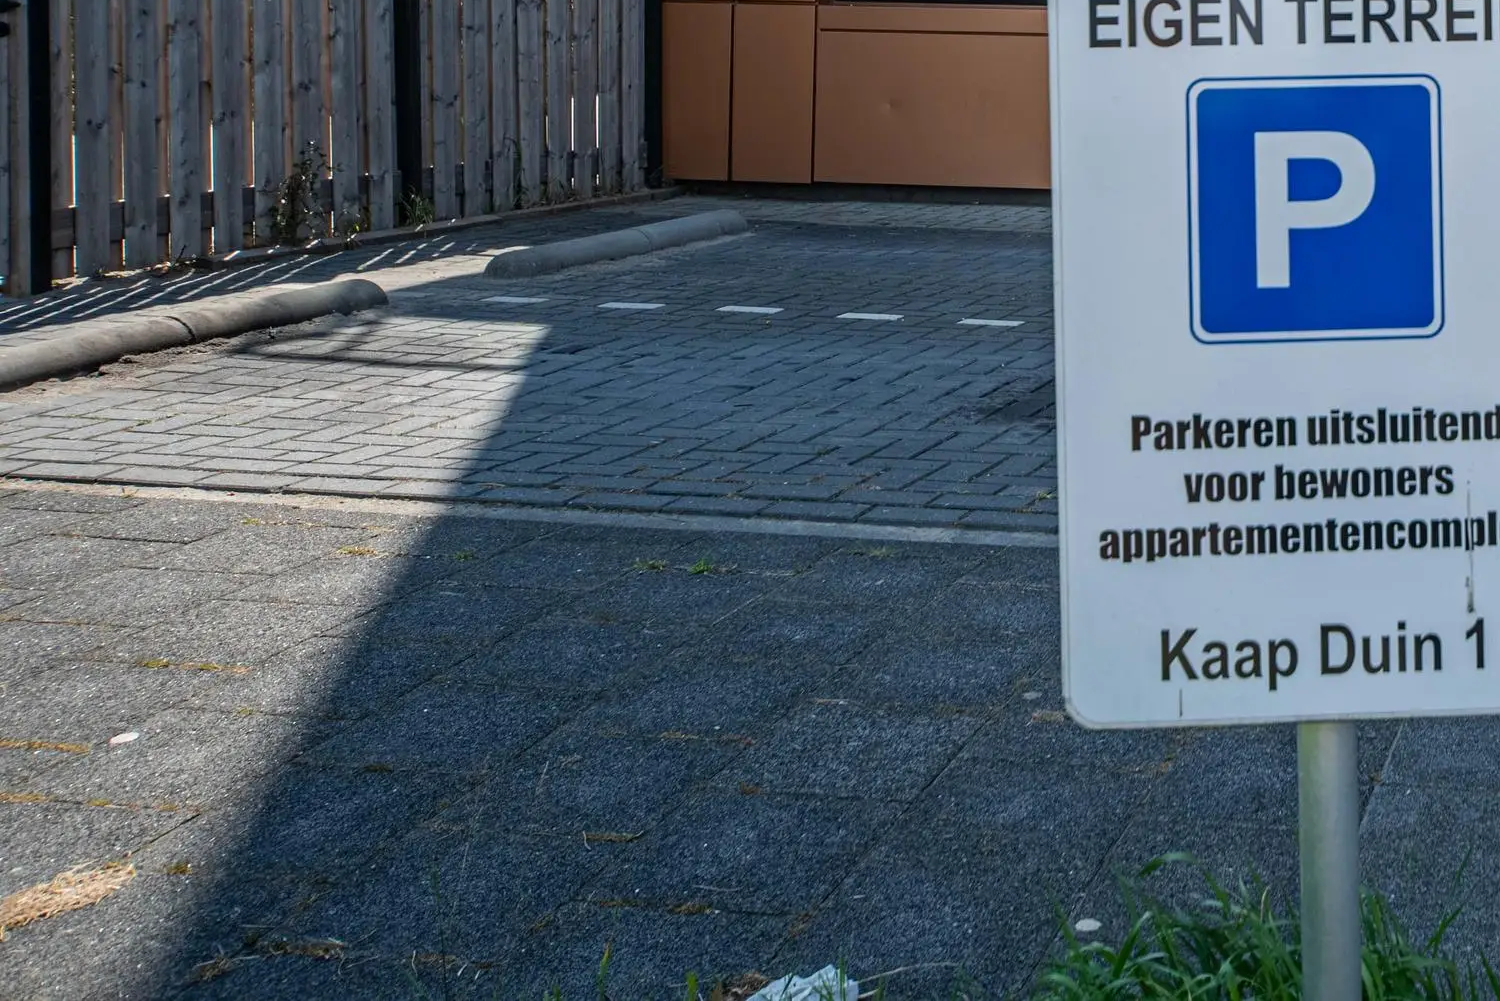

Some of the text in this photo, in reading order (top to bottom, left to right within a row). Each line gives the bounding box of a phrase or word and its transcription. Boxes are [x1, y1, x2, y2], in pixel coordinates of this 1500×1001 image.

[1253, 130, 1377, 290] P
[1131, 413, 1297, 452] Parkeren
[1183, 463, 1455, 503] voor bewoners
[1160, 617, 1487, 692] Kaap Duin 1
